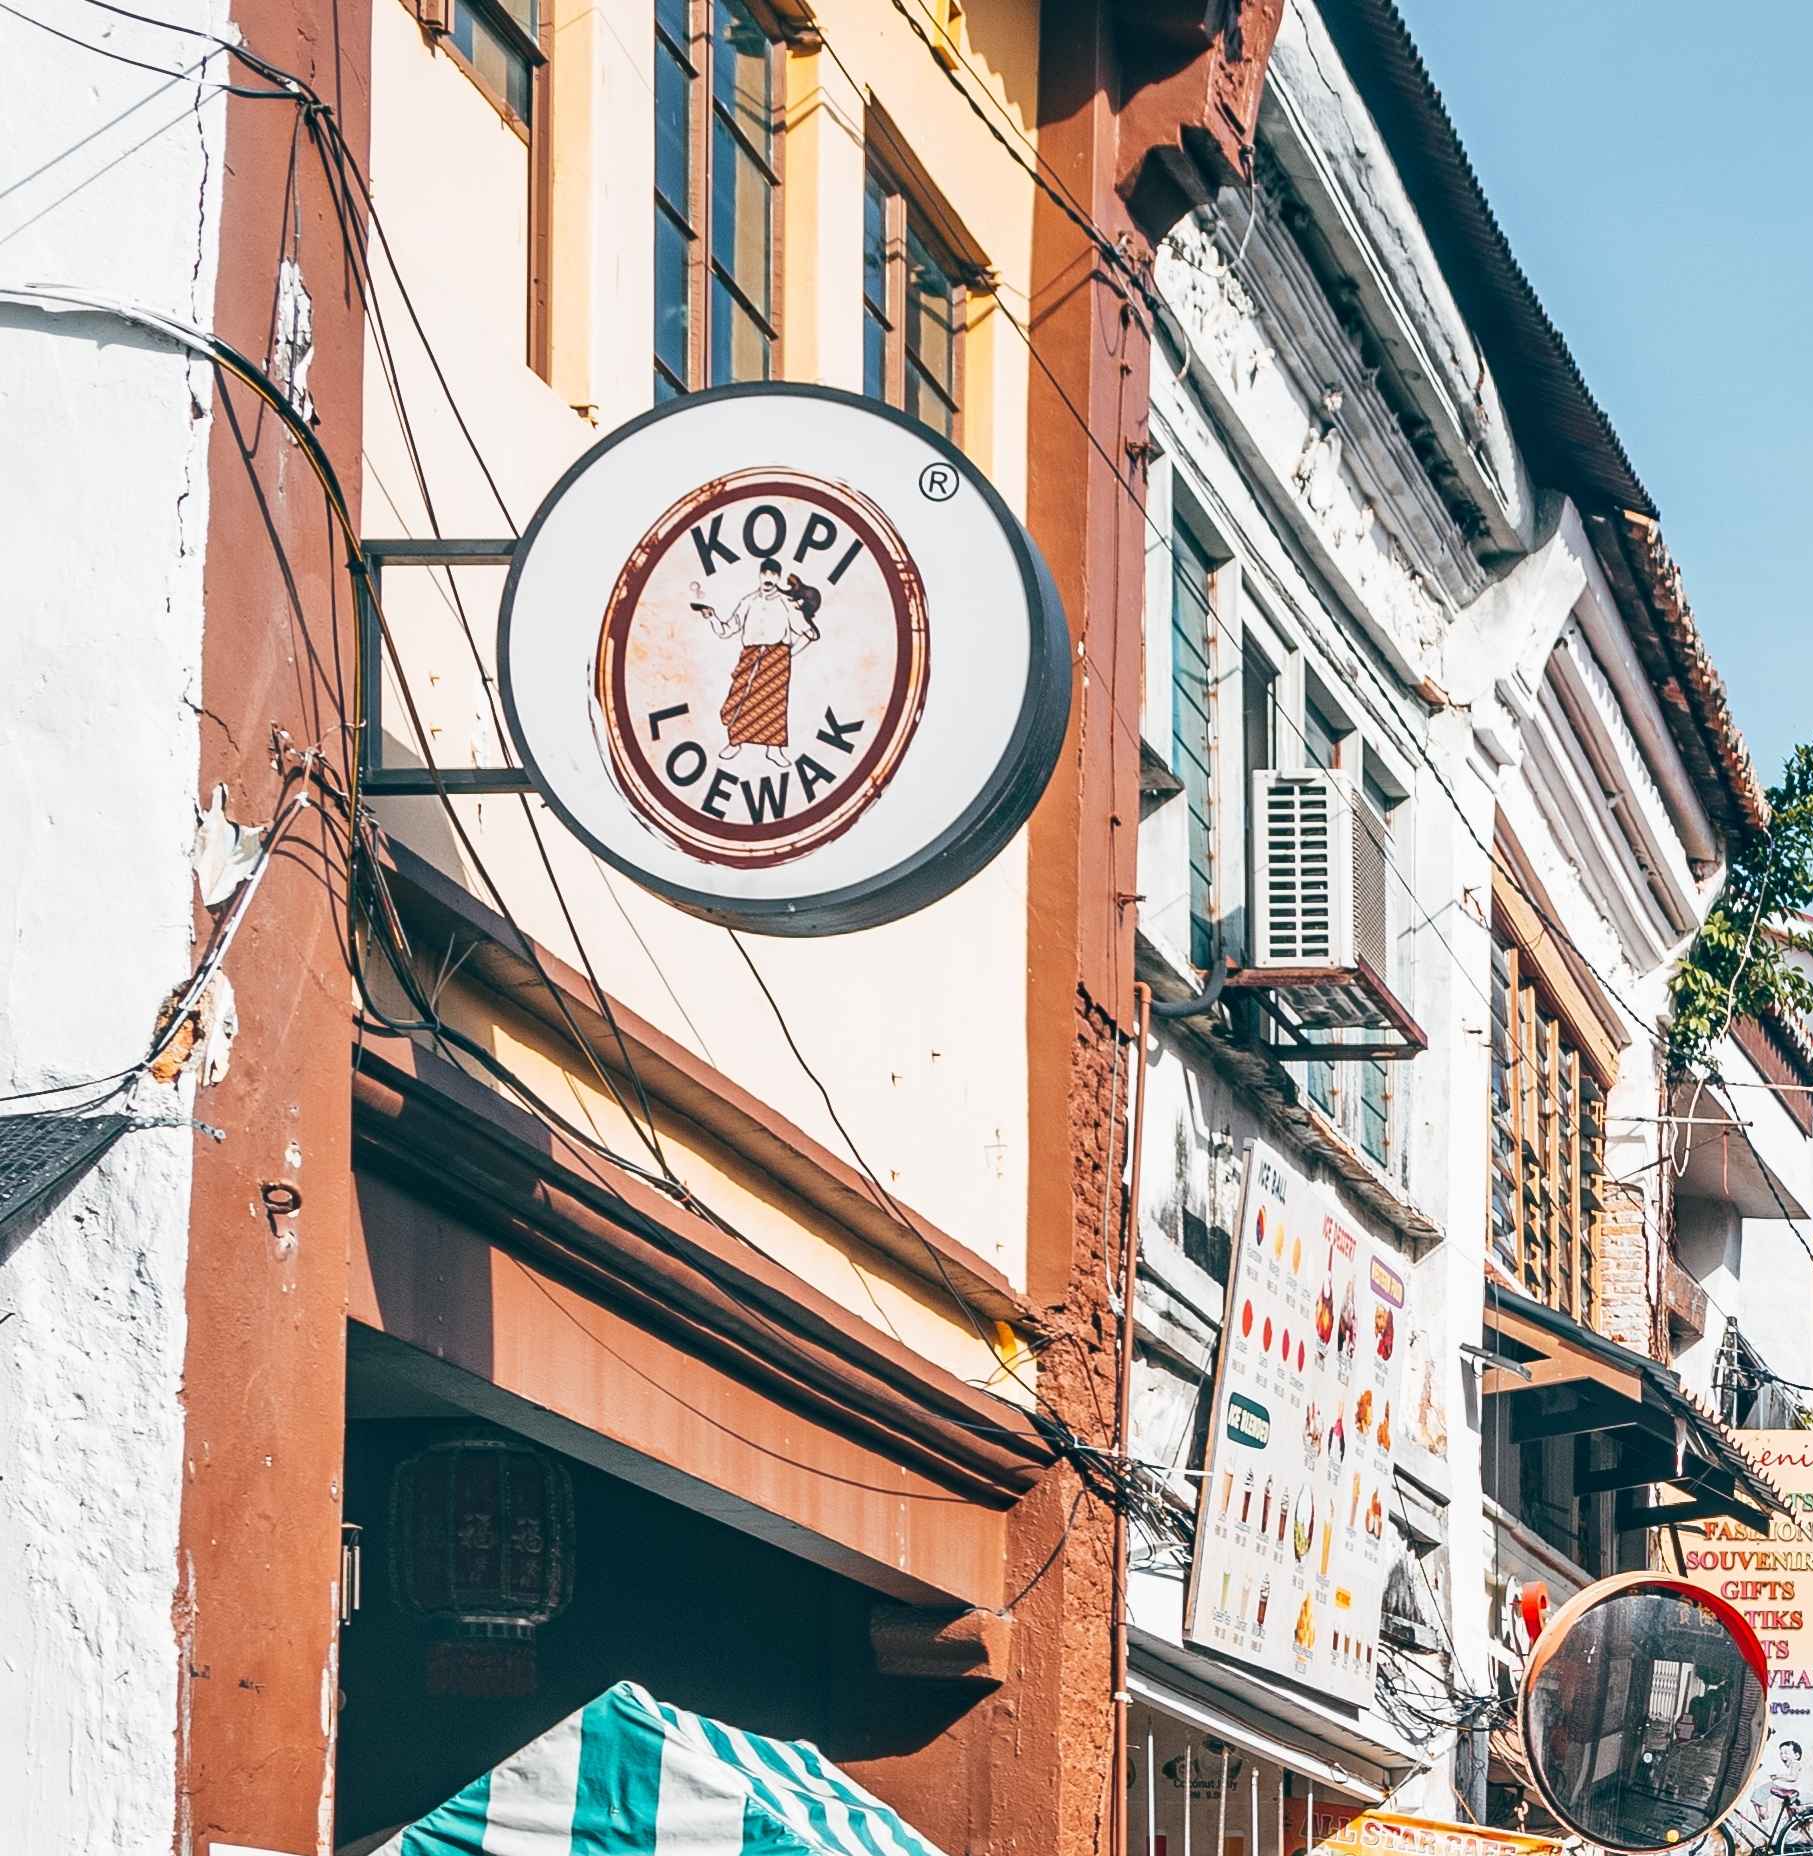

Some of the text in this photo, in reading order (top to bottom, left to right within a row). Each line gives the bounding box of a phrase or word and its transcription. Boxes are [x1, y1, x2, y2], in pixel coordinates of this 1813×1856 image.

[690, 504, 863, 585] KOPI
[648, 704, 865, 825] LOEWAK
[1721, 1581, 1795, 1600] GIFTS
[1745, 1610, 1803, 1629] TIKS
[1302, 1813, 1358, 1844] ALL
[1361, 1820, 1437, 1855] STAR
